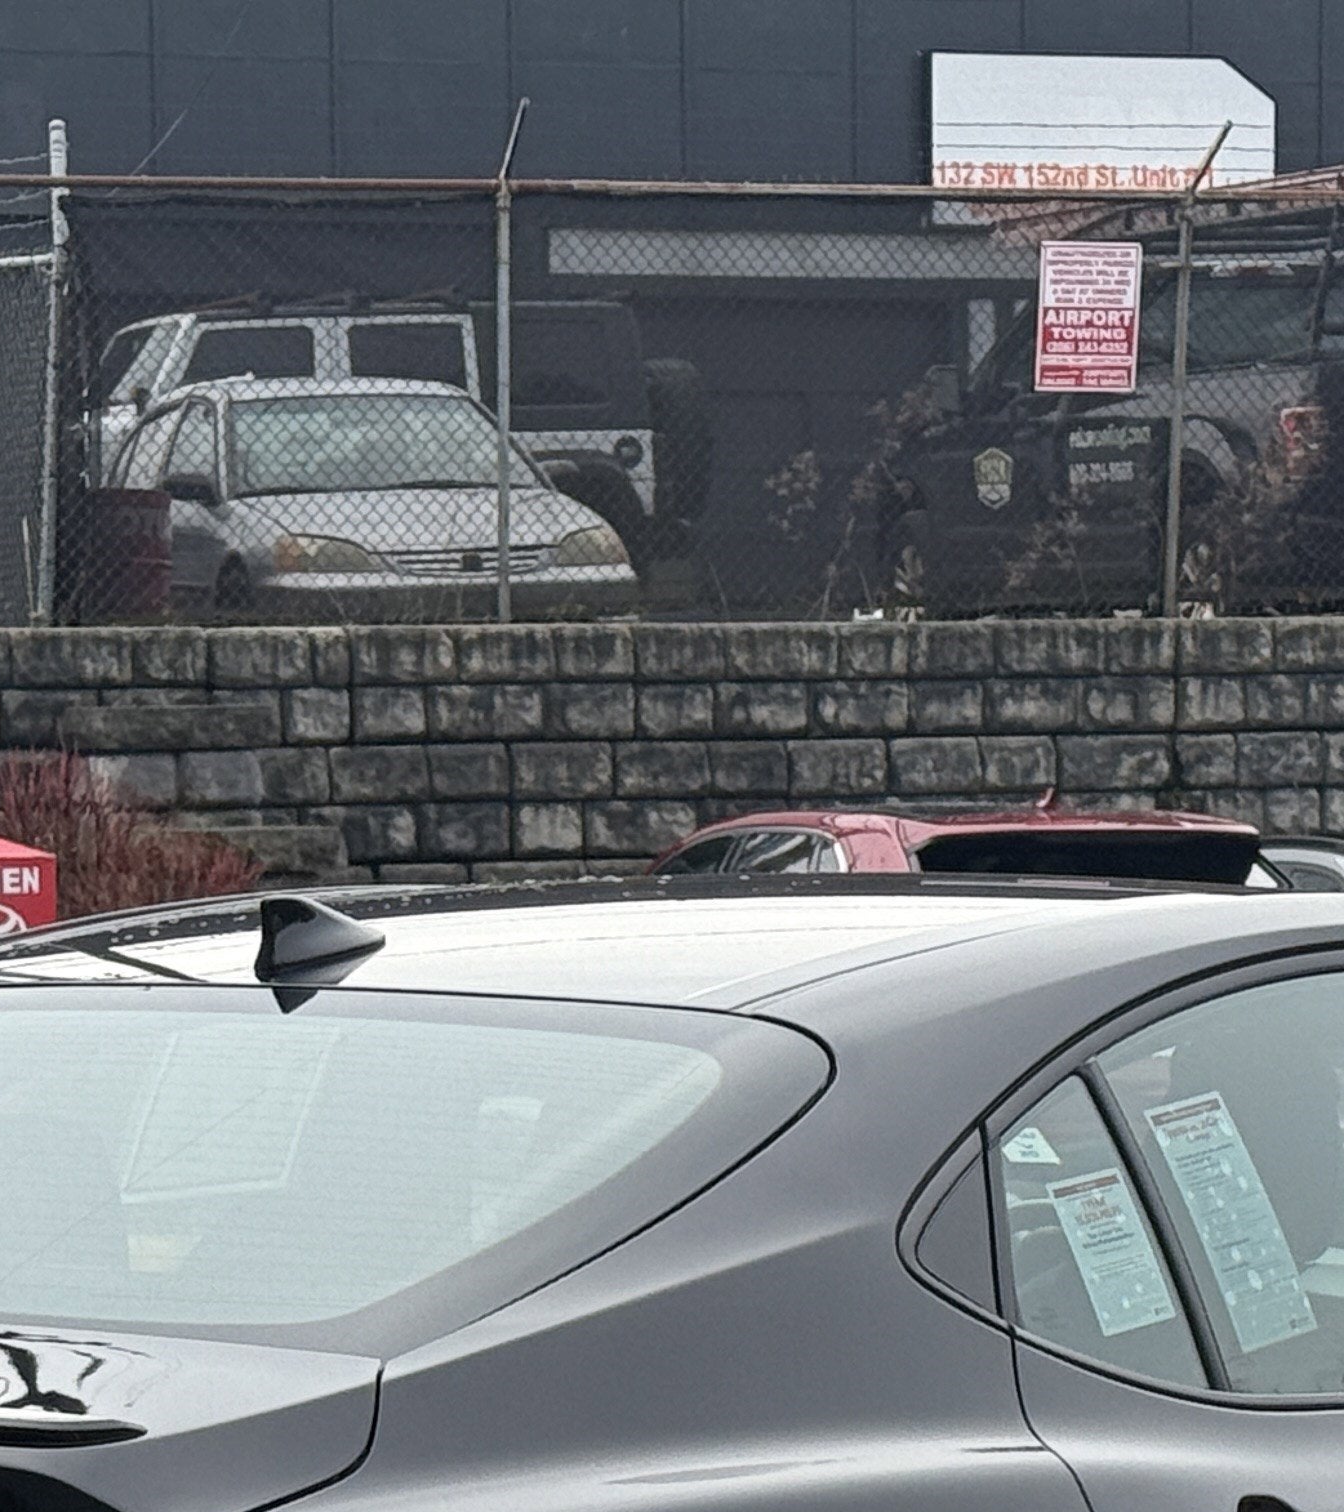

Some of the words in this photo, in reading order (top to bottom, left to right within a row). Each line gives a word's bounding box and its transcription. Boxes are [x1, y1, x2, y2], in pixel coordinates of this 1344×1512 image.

[936, 161, 976, 185] 132
[980, 162, 1017, 186] SW
[1024, 163, 1089, 187] 152nd
[1131, 164, 1180, 188] Unit
[1044, 309, 1134, 327] AIRPORT
[1051, 327, 1127, 340] TOWING
